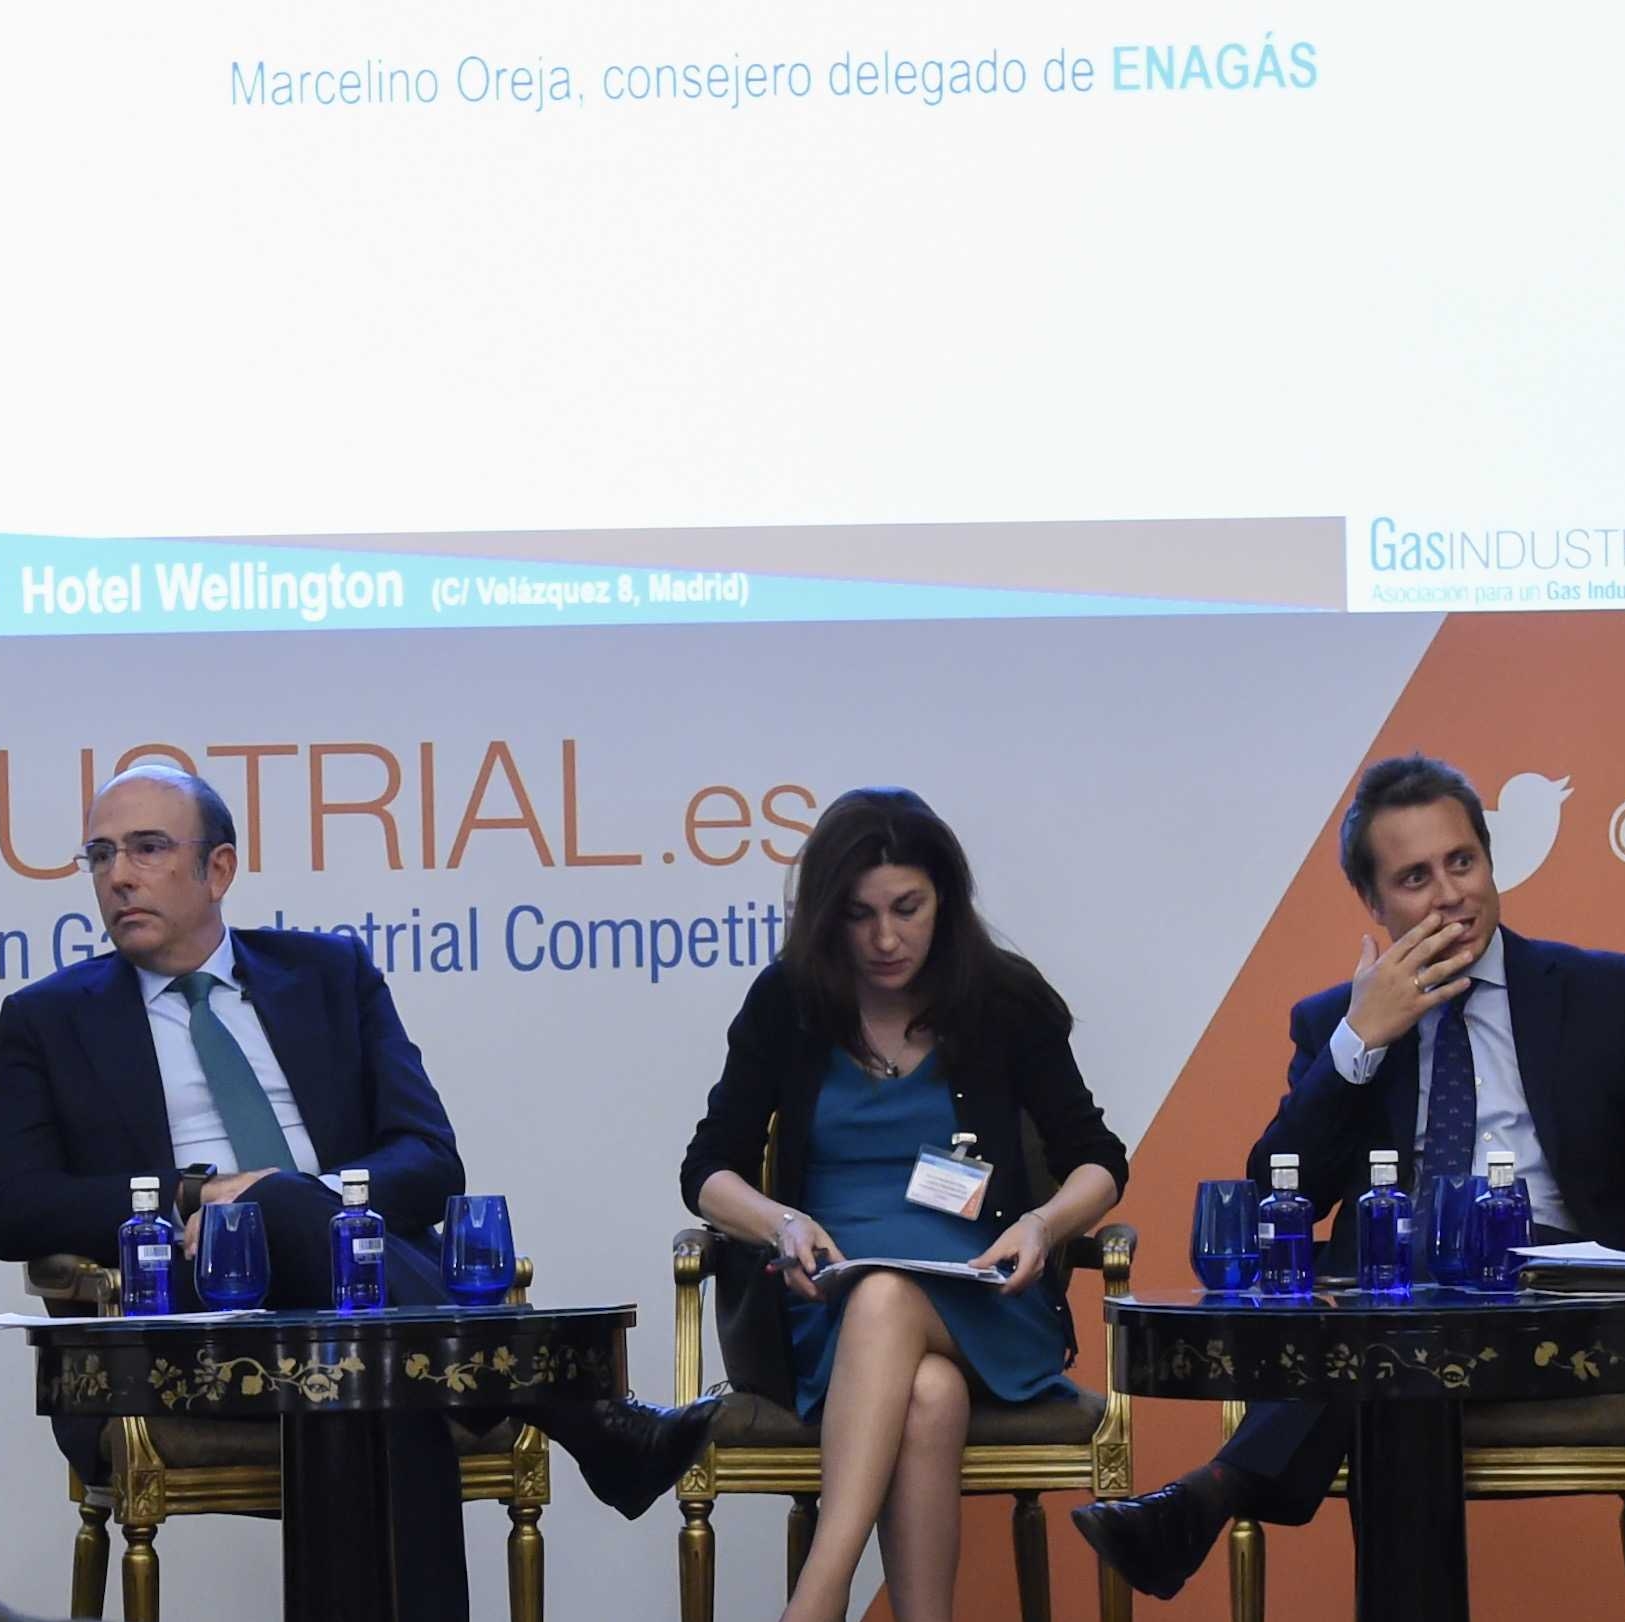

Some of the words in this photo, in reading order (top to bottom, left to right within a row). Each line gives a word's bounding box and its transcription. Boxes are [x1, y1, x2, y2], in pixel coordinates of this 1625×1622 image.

[231, 59, 439, 106] Marcelino
[457, 55, 586, 112] Oreja,
[603, 52, 813, 110] consejero
[829, 48, 1027, 106] delegado
[1044, 47, 1094, 93] de
[1112, 31, 1319, 91] ENAGÁS
[21, 563, 142, 615] Hotel
[155, 561, 404, 622] Wellington
[432, 576, 470, 612] (C/
[475, 574, 612, 610] Velázquez
[648, 571, 750, 606] Madrid)
[1547, 579, 1581, 600] Gas
[505, 900, 790, 984] Competit
